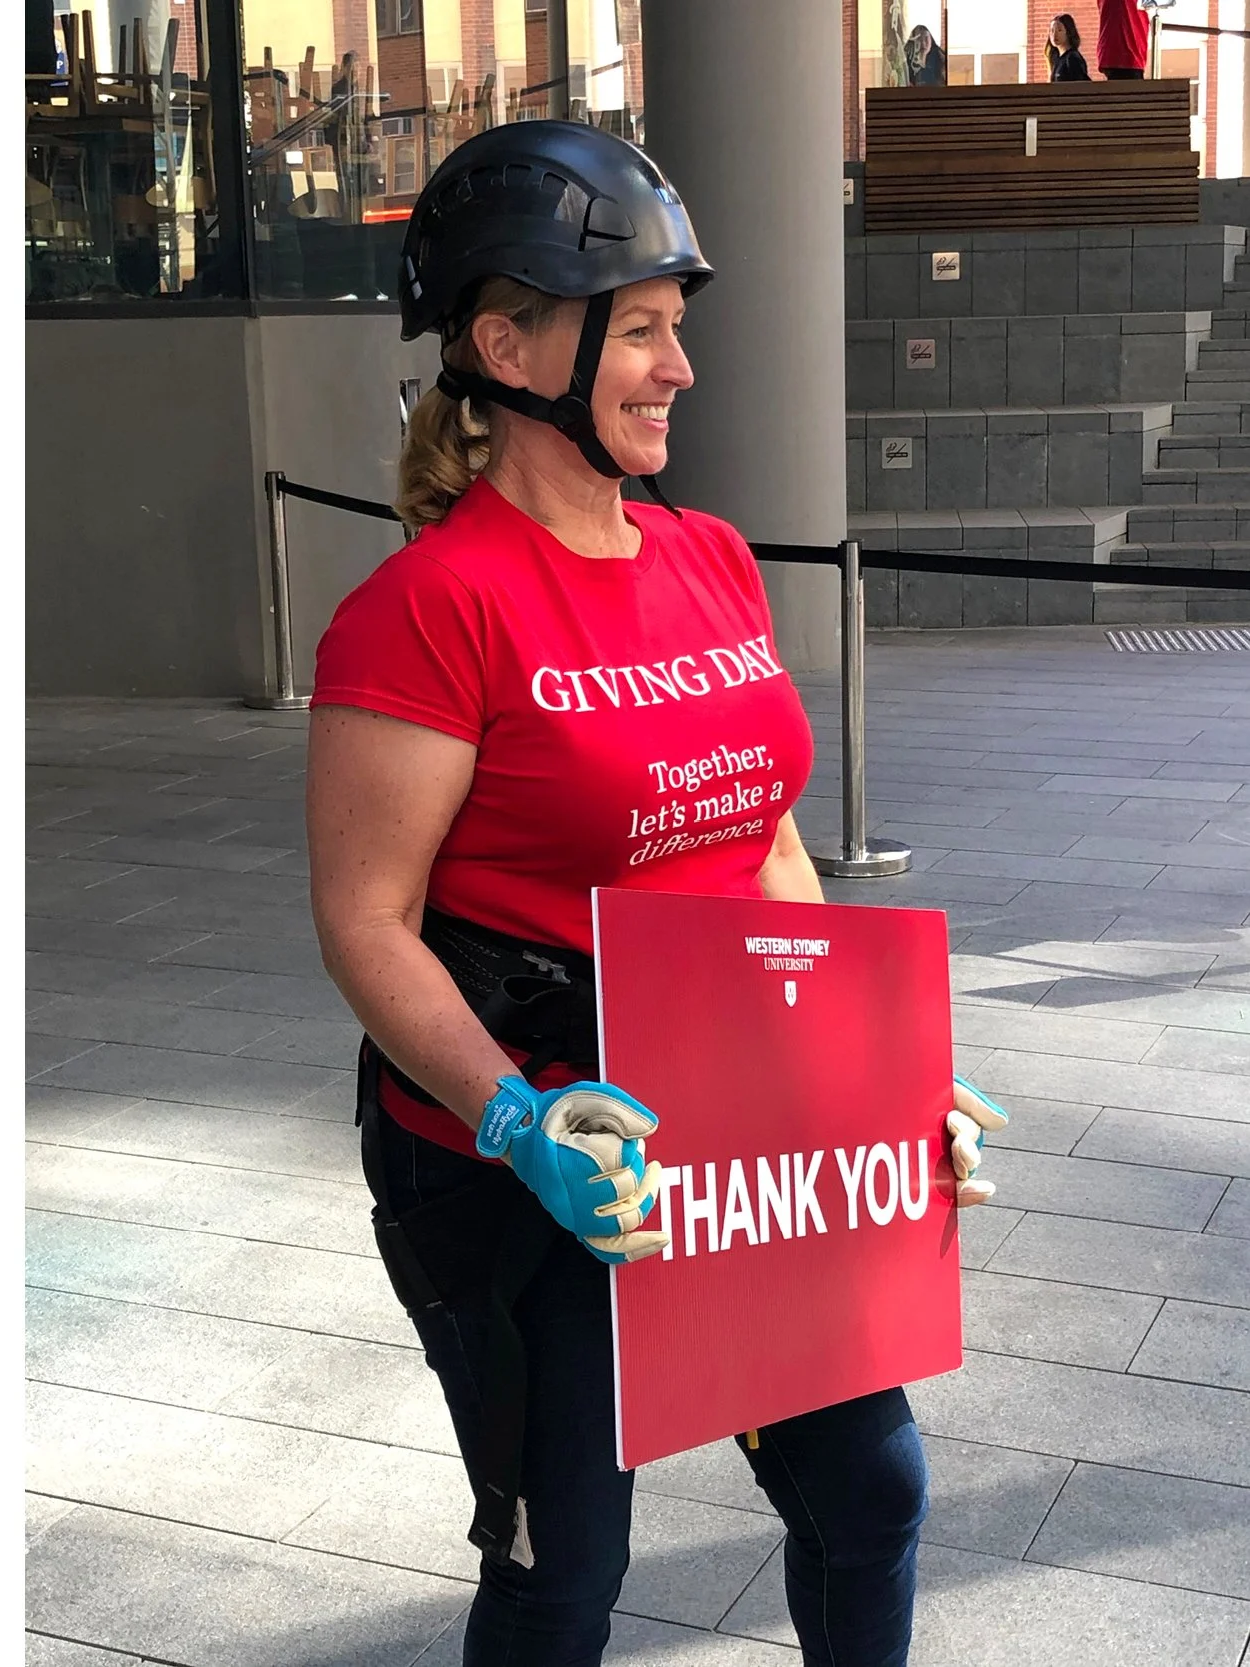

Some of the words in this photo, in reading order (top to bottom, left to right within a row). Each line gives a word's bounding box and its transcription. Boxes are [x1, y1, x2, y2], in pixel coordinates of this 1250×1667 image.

[531, 654, 711, 713] GIVING
[703, 634, 784, 688] DAY
[648, 744, 774, 794] Together,
[627, 799, 686, 839] let's
[693, 781, 763, 823] make
[769, 780, 784, 801] a
[629, 818, 764, 866] difference.
[744, 936, 792, 955] WESTERN
[792, 938, 830, 957] SYDNEY
[763, 957, 814, 972] UNIVERSITY
[656, 1150, 828, 1261] THANK
[833, 1139, 929, 1230] YOU
